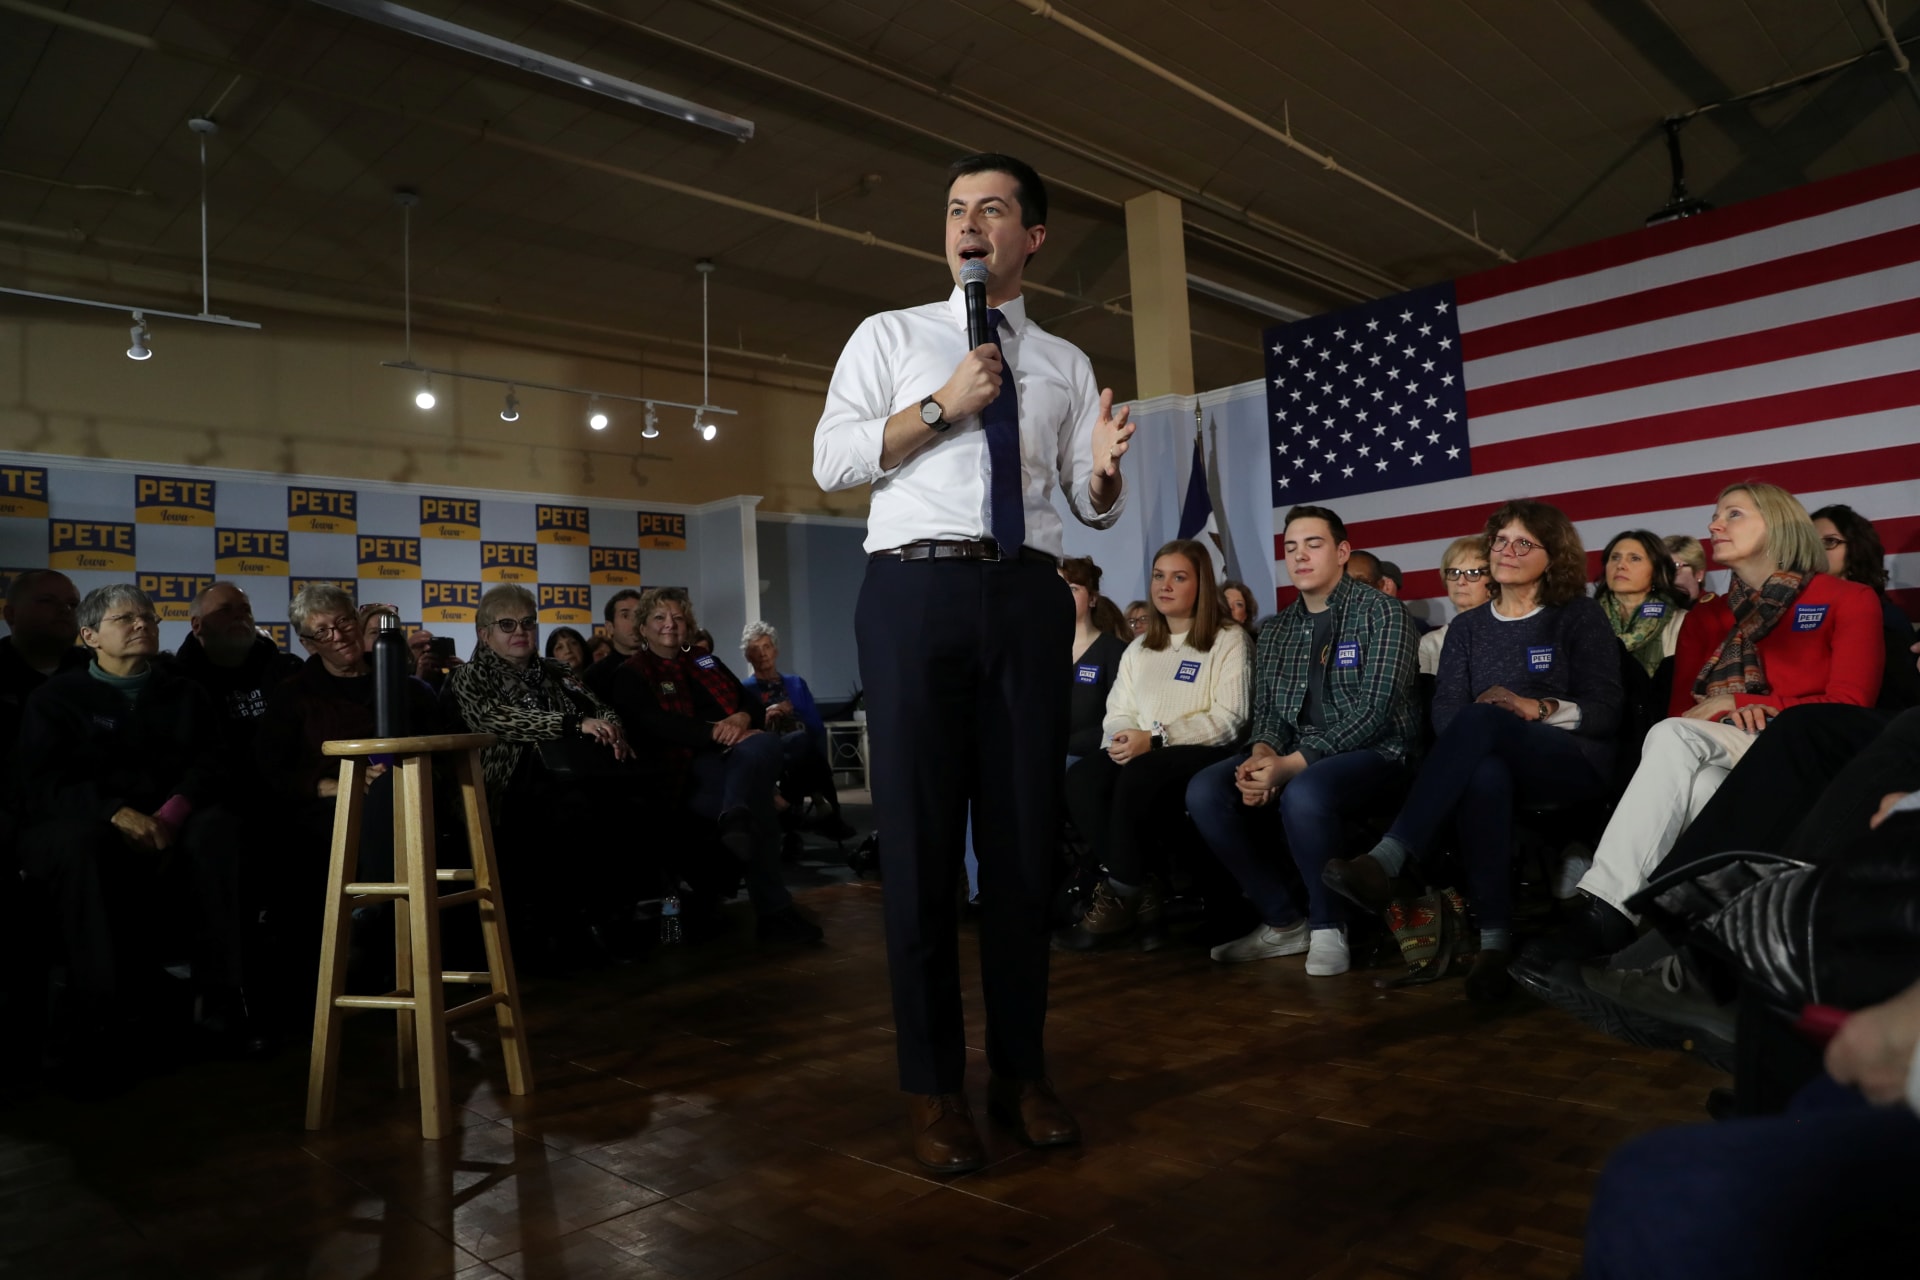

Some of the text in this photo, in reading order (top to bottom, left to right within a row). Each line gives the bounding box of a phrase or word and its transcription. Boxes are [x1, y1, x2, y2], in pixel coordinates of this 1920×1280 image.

[0, 469, 43, 495] TE
[138, 479, 212, 506] PETE
[291, 490, 354, 515] PETE
[160, 510, 189, 521] Iowa
[422, 499, 478, 522] PETE
[538, 507, 588, 529] PETE
[311, 518, 335, 530] Iowa
[438, 526, 461, 536] Iowa
[640, 513, 684, 534] PETE
[52, 523, 133, 550] PETE
[217, 531, 286, 556] PETE
[359, 538, 418, 561] PETE
[482, 543, 536, 565] PETE
[591, 549, 639, 569] PETE
[76, 555, 108, 567] Iowa
[238, 561, 266, 572] Iowa
[377, 565, 401, 576] Iowa
[423, 583, 479, 605] PETE
[540, 586, 589, 606] PETE
[161, 605, 190, 617] Iowa
[440, 609, 463, 620] Iowa
[1532, 654, 1551, 662] PETE
